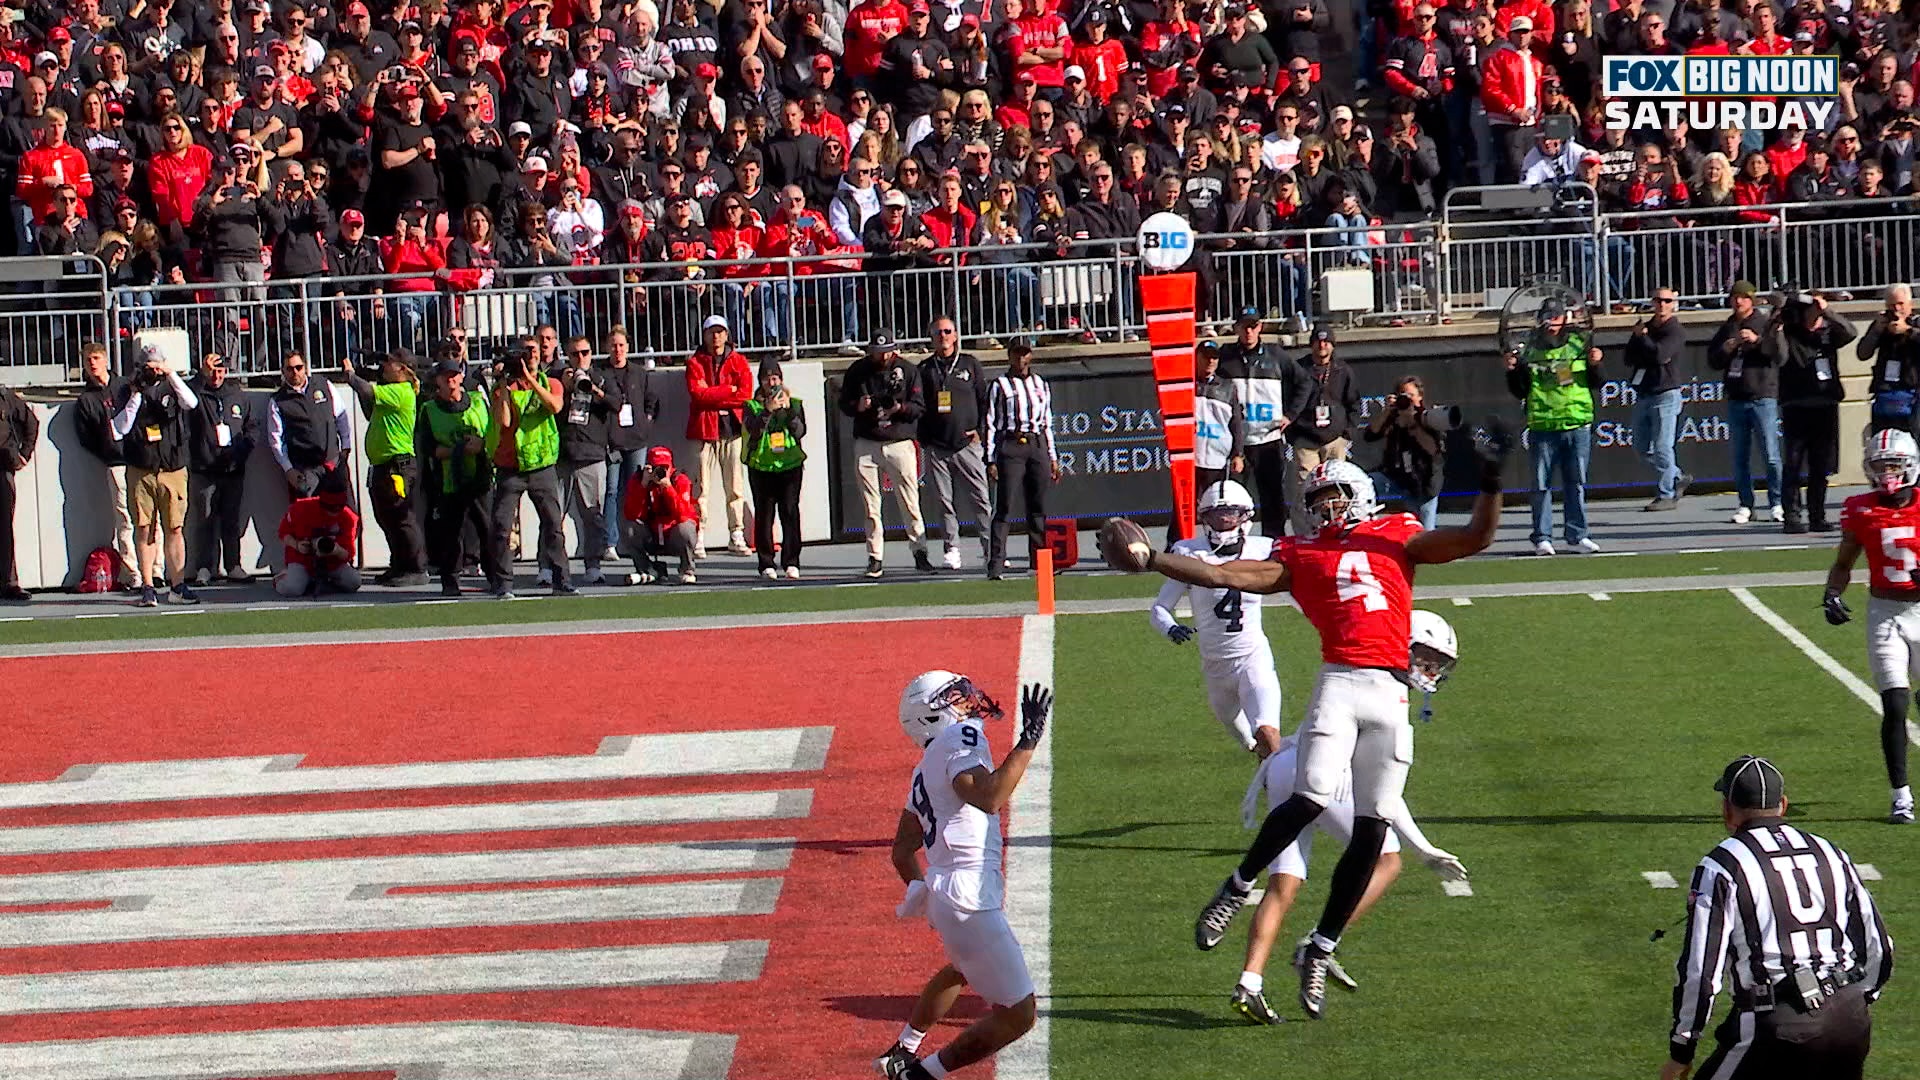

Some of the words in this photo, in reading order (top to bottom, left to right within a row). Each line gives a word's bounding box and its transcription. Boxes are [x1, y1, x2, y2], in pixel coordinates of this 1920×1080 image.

[667, 36, 718, 53] OHIO
[1095, 55, 1108, 82] 1
[1100, 404, 1162, 434] STA
[1677, 415, 1731, 443] Ath
[1880, 525, 1919, 583] 5
[1335, 550, 1390, 613] 4
[1213, 586, 1244, 633] 4
[960, 724, 979, 747] 9
[912, 770, 938, 850] 9
[1769, 852, 1827, 925] U
